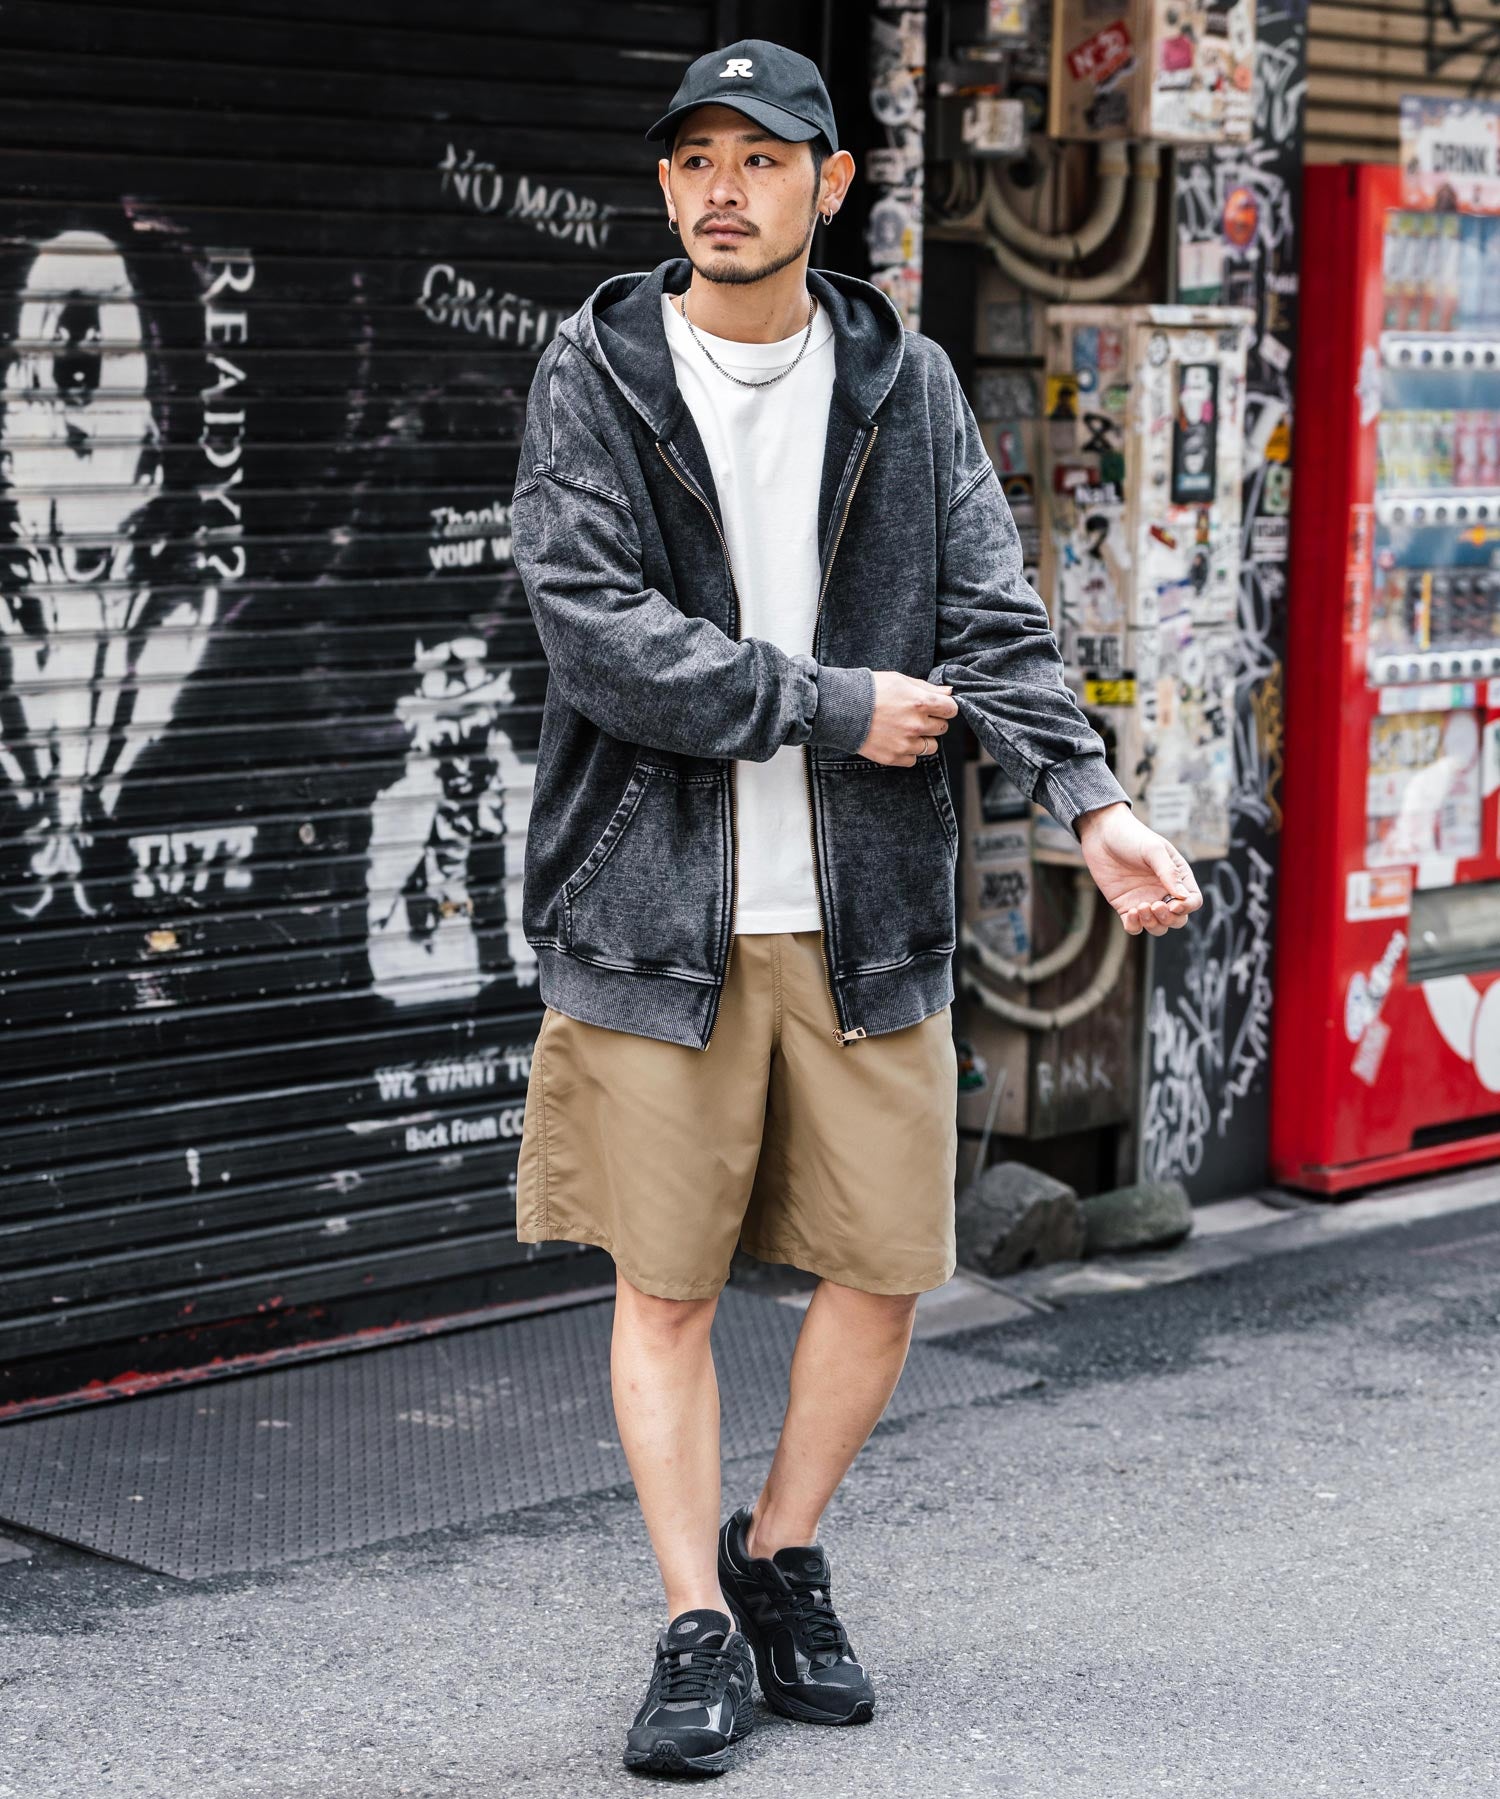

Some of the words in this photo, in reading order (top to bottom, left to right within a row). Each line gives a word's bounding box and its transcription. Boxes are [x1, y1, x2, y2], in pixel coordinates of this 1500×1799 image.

[719, 58, 754, 78] R
[437, 143, 503, 213] NO
[1431, 141, 1488, 175] DRINK
[415, 263, 566, 347] GRAFFI
[427, 538, 486, 582] your
[375, 1061, 418, 1101] WE
[422, 1047, 500, 1094] WANT
[405, 1122, 449, 1152] Back
[450, 1116, 498, 1145] From
